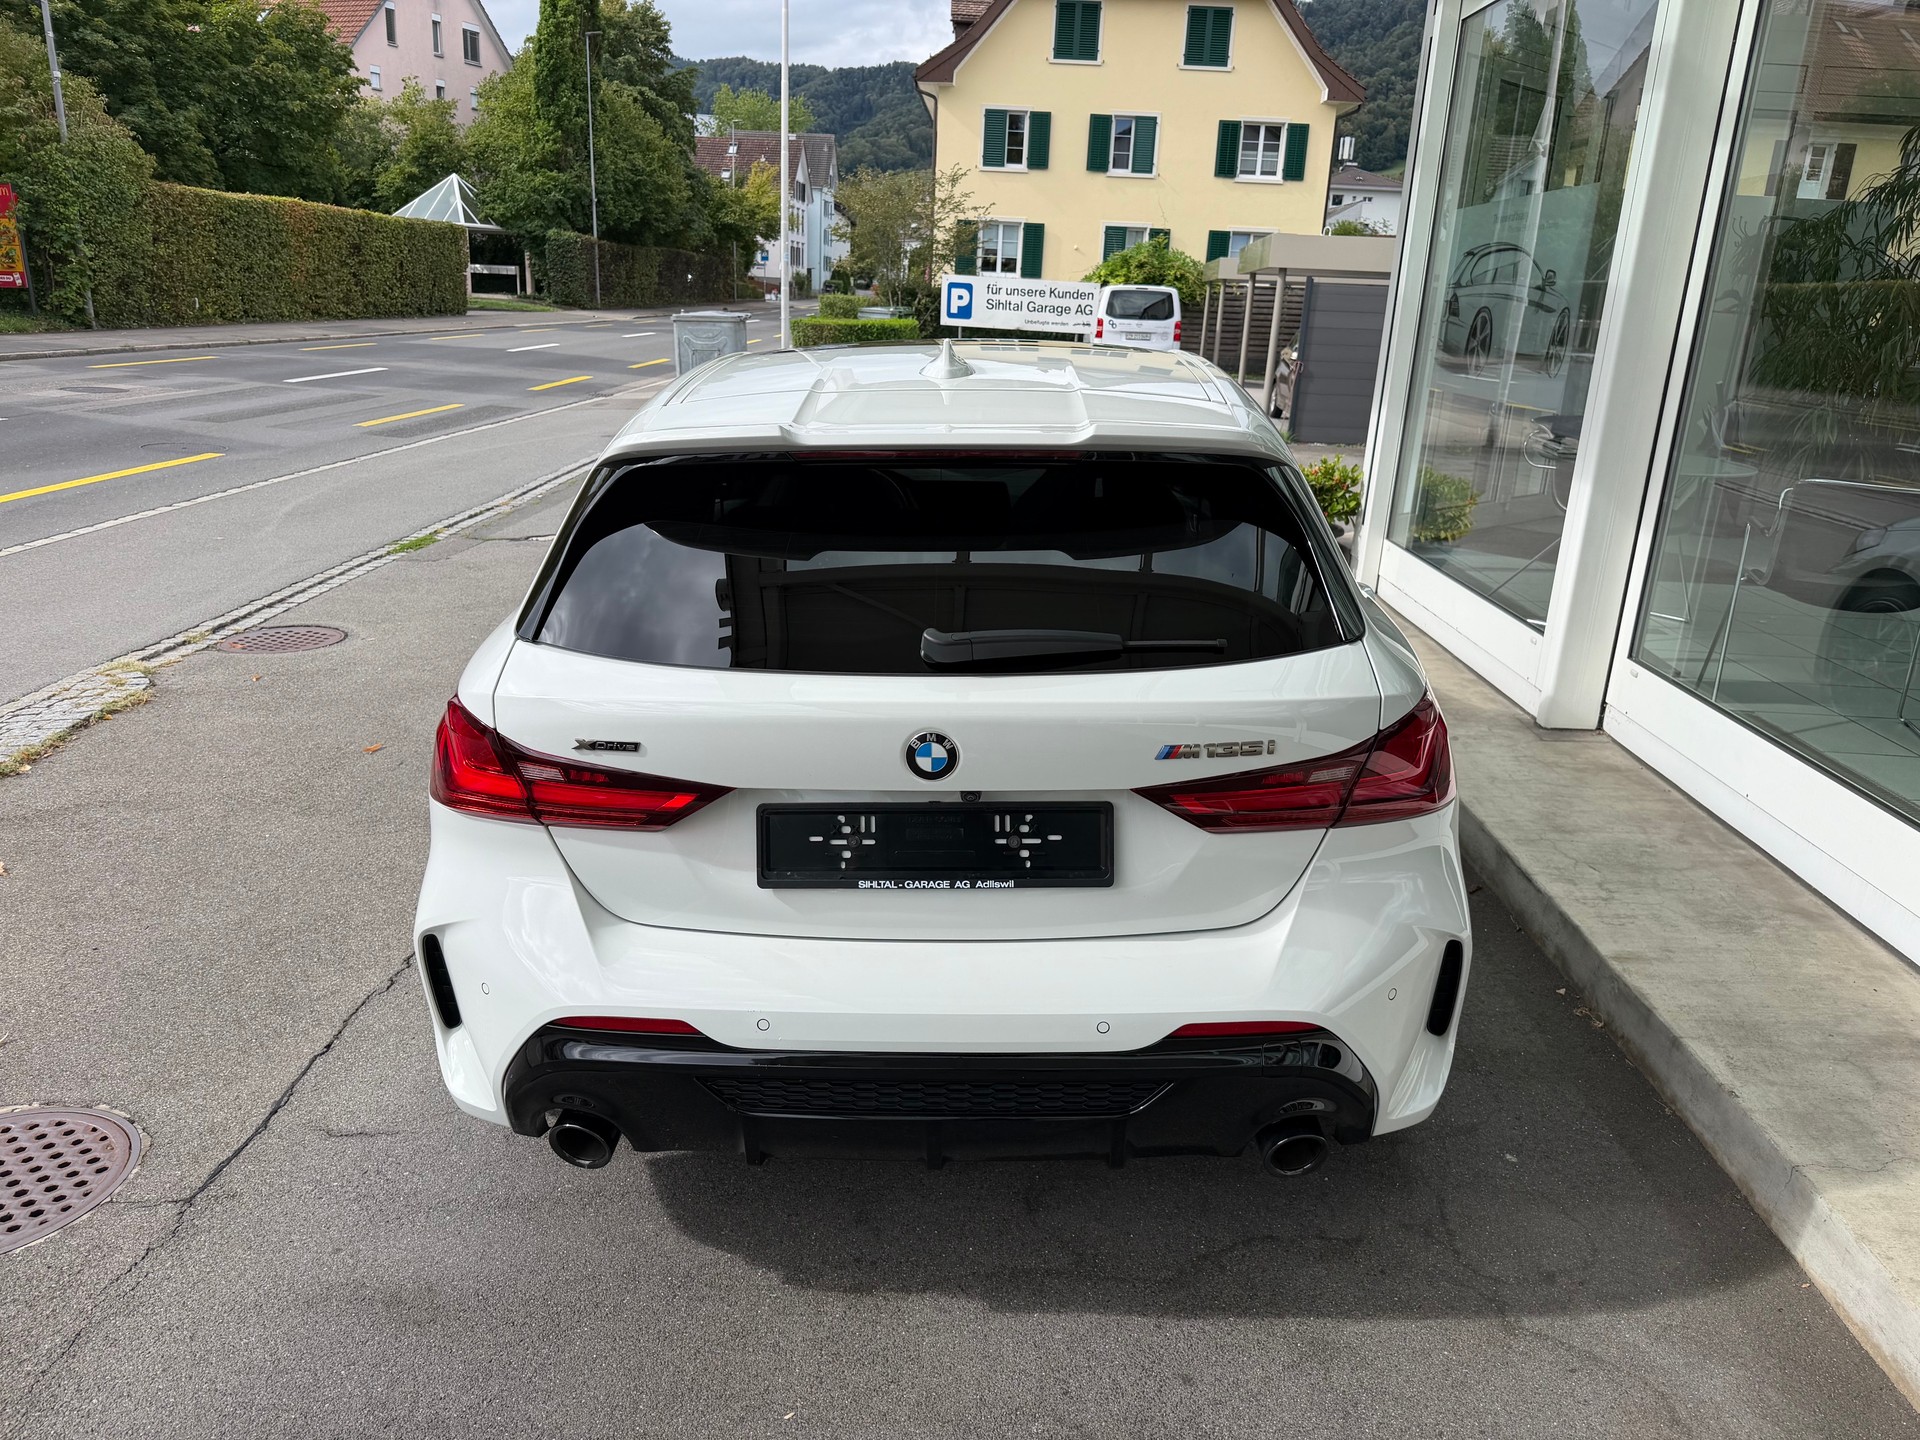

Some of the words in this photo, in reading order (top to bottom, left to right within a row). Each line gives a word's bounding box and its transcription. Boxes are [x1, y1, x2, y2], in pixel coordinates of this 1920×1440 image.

[986, 284, 1003, 295] für
[1005, 287, 1046, 298] unsere
[1049, 287, 1094, 300] Kunden
[950, 288, 971, 314] P
[986, 298, 1023, 312] Sihltal
[1026, 301, 1071, 316] Garage
[1075, 304, 1093, 316] AG
[910, 733, 954, 750] BMW
[858, 880, 897, 889] SIHLTAL
[904, 880, 950, 889] GARAGE
[954, 880, 971, 889] AG
[975, 879, 1015, 889] Adliswil
